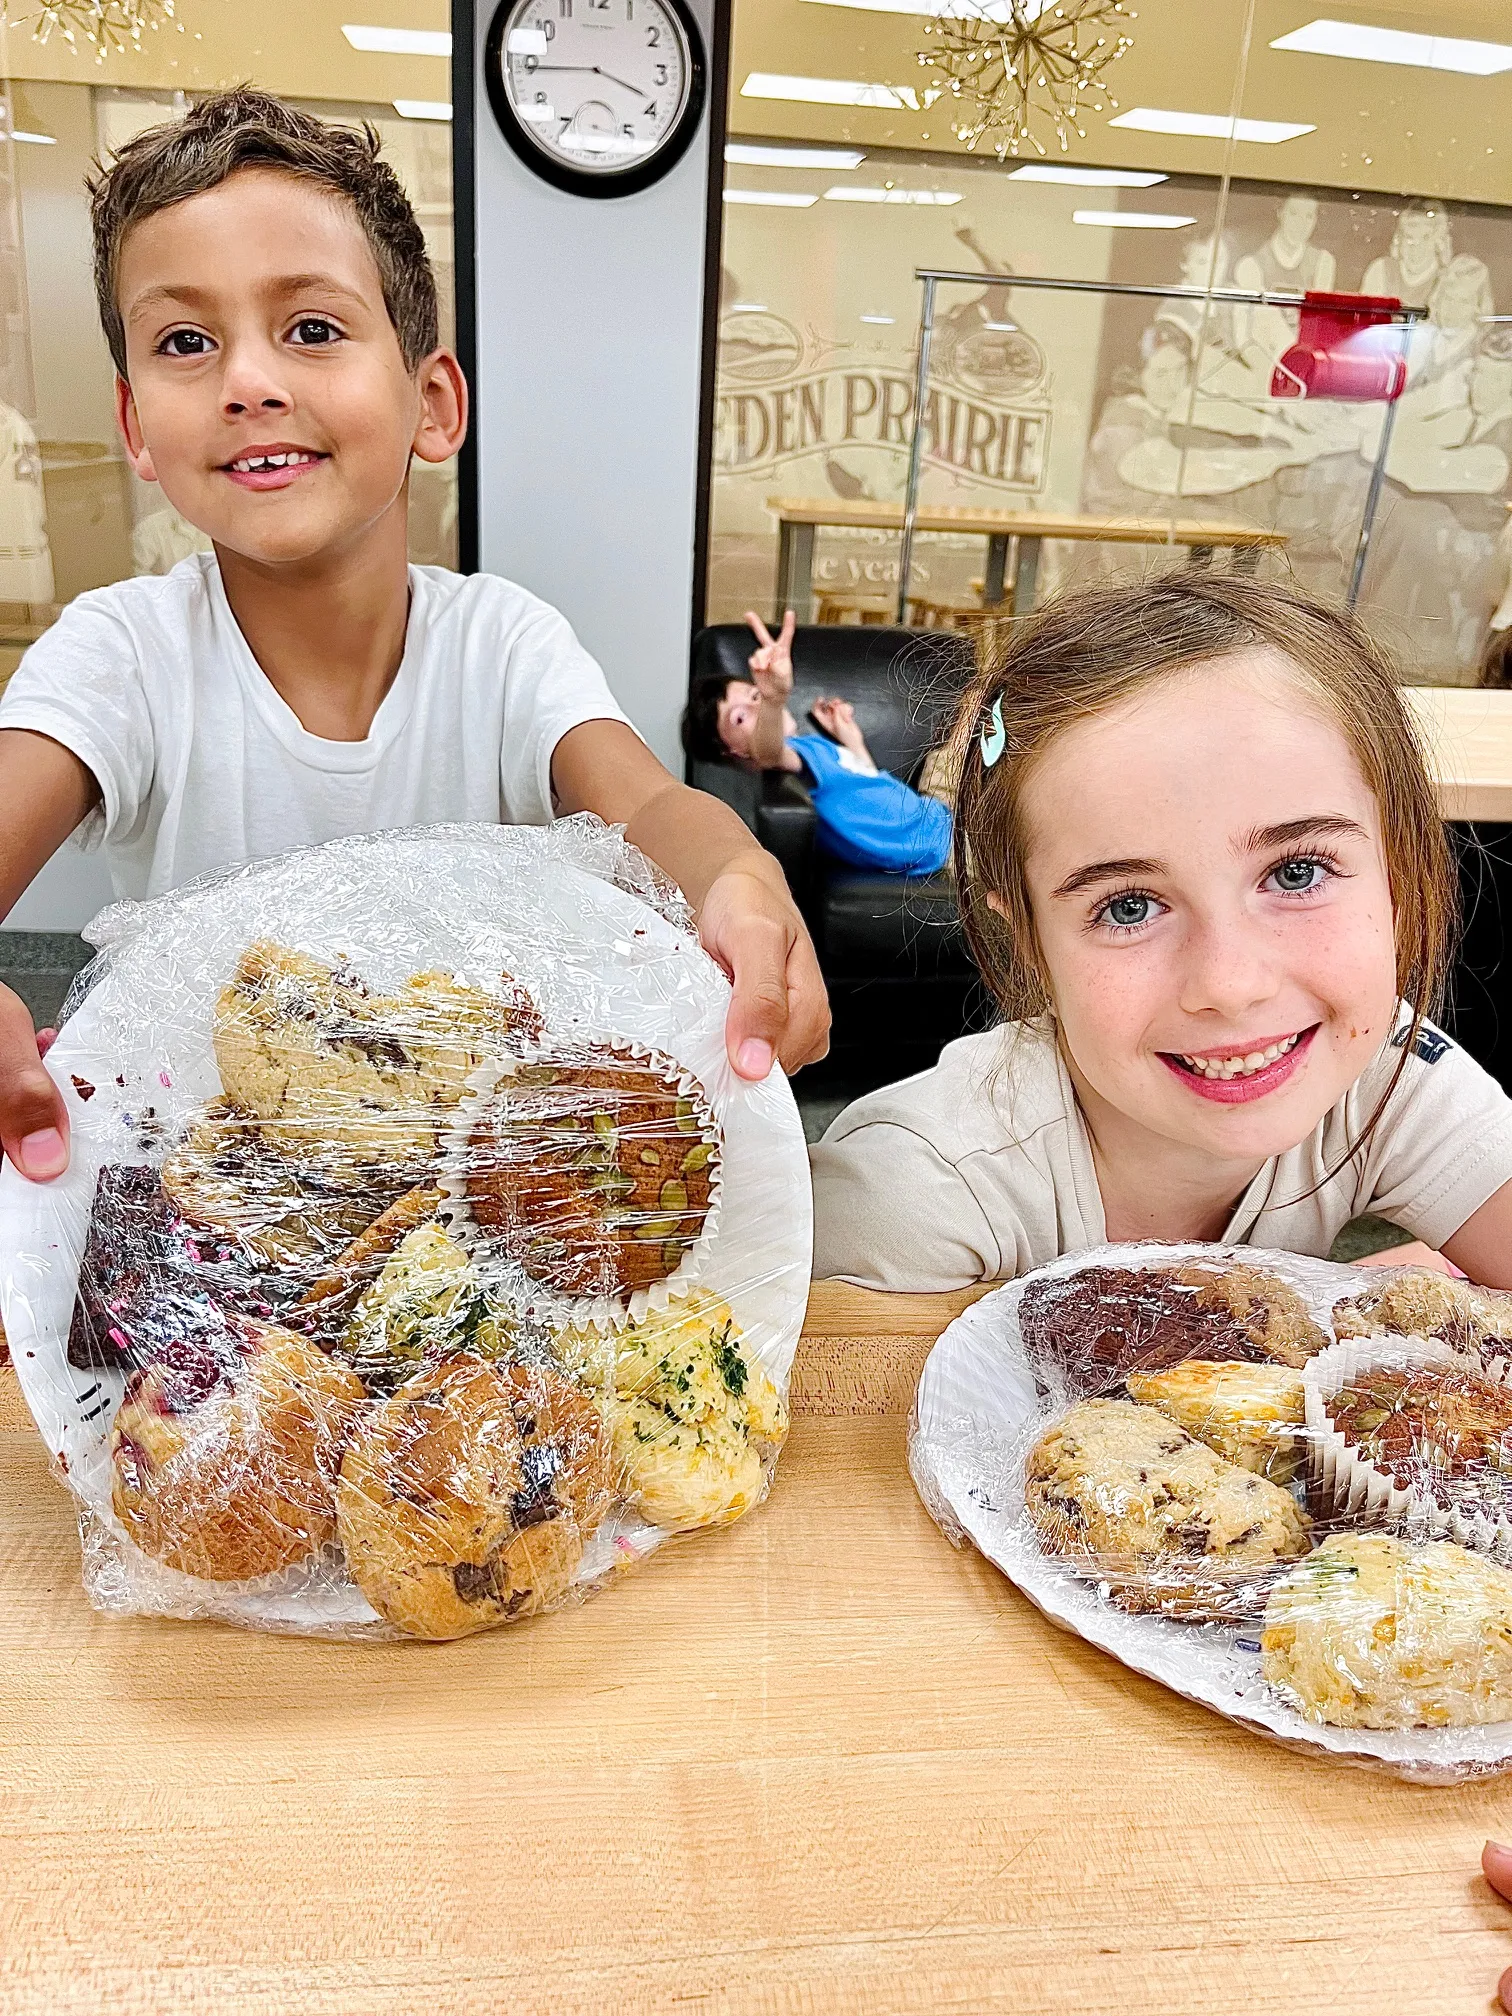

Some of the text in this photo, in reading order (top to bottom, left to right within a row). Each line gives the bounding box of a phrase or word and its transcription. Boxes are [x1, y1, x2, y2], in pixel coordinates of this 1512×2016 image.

[645, 26, 660, 47] 2
[524, 54, 539, 75] 9
[653, 64, 668, 86] 3
[643, 100, 658, 119] 4
[841, 374, 1042, 487] PRAIRIE
[846, 557, 931, 588] yeas
